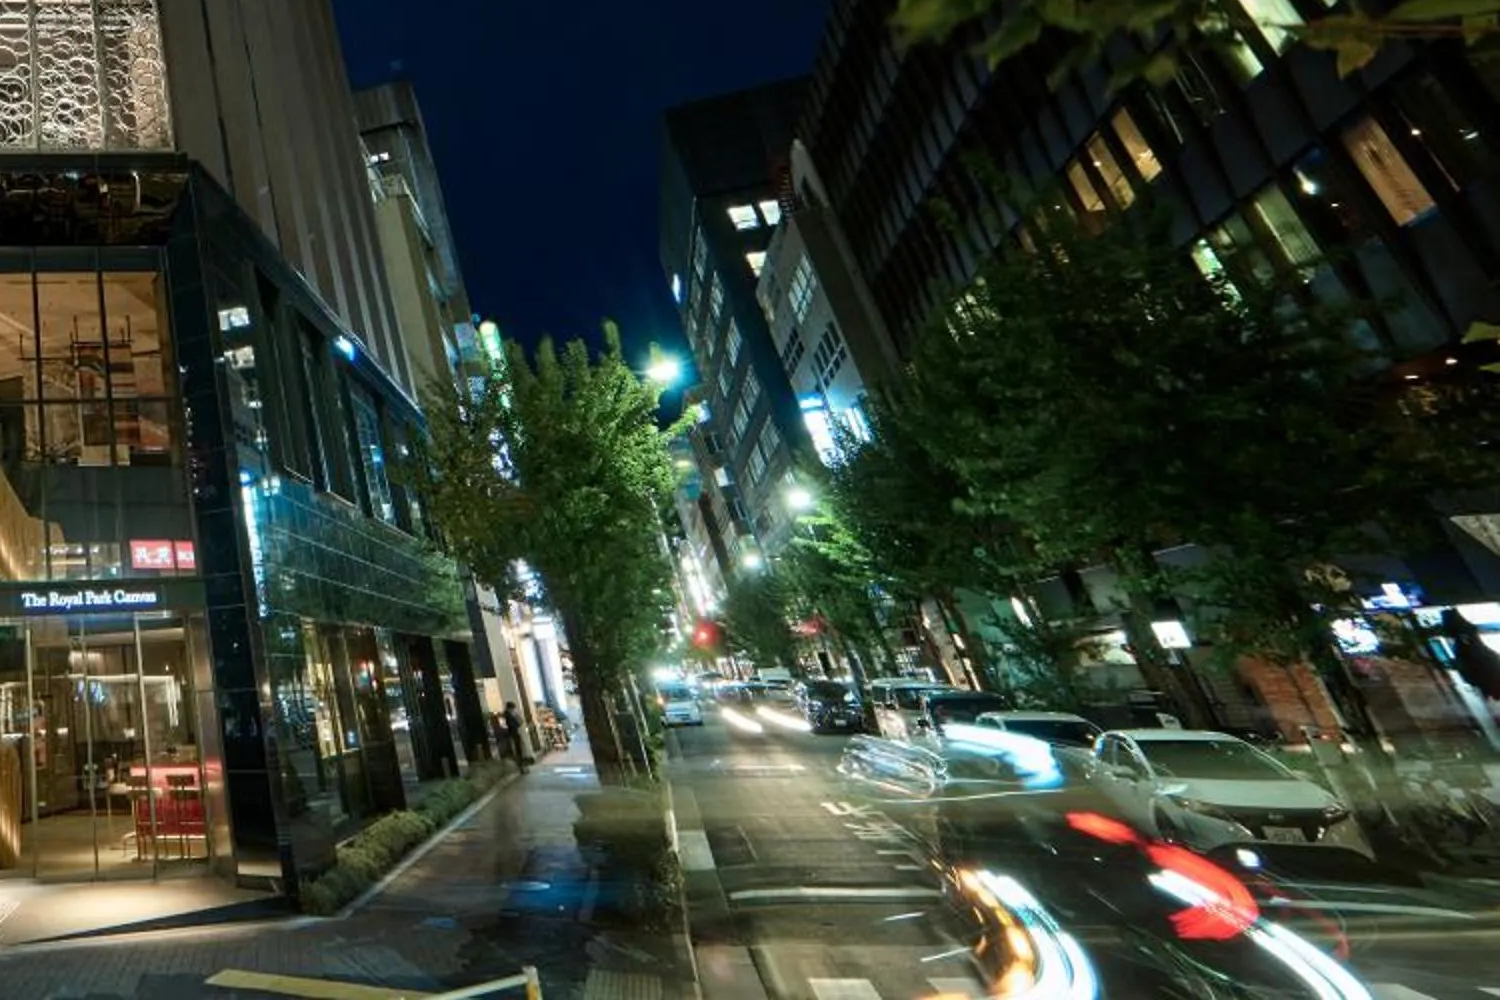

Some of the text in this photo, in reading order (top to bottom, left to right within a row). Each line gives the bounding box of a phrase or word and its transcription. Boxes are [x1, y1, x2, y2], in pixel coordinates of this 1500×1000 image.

[21, 588, 158, 609] The Royal Park Canvas
